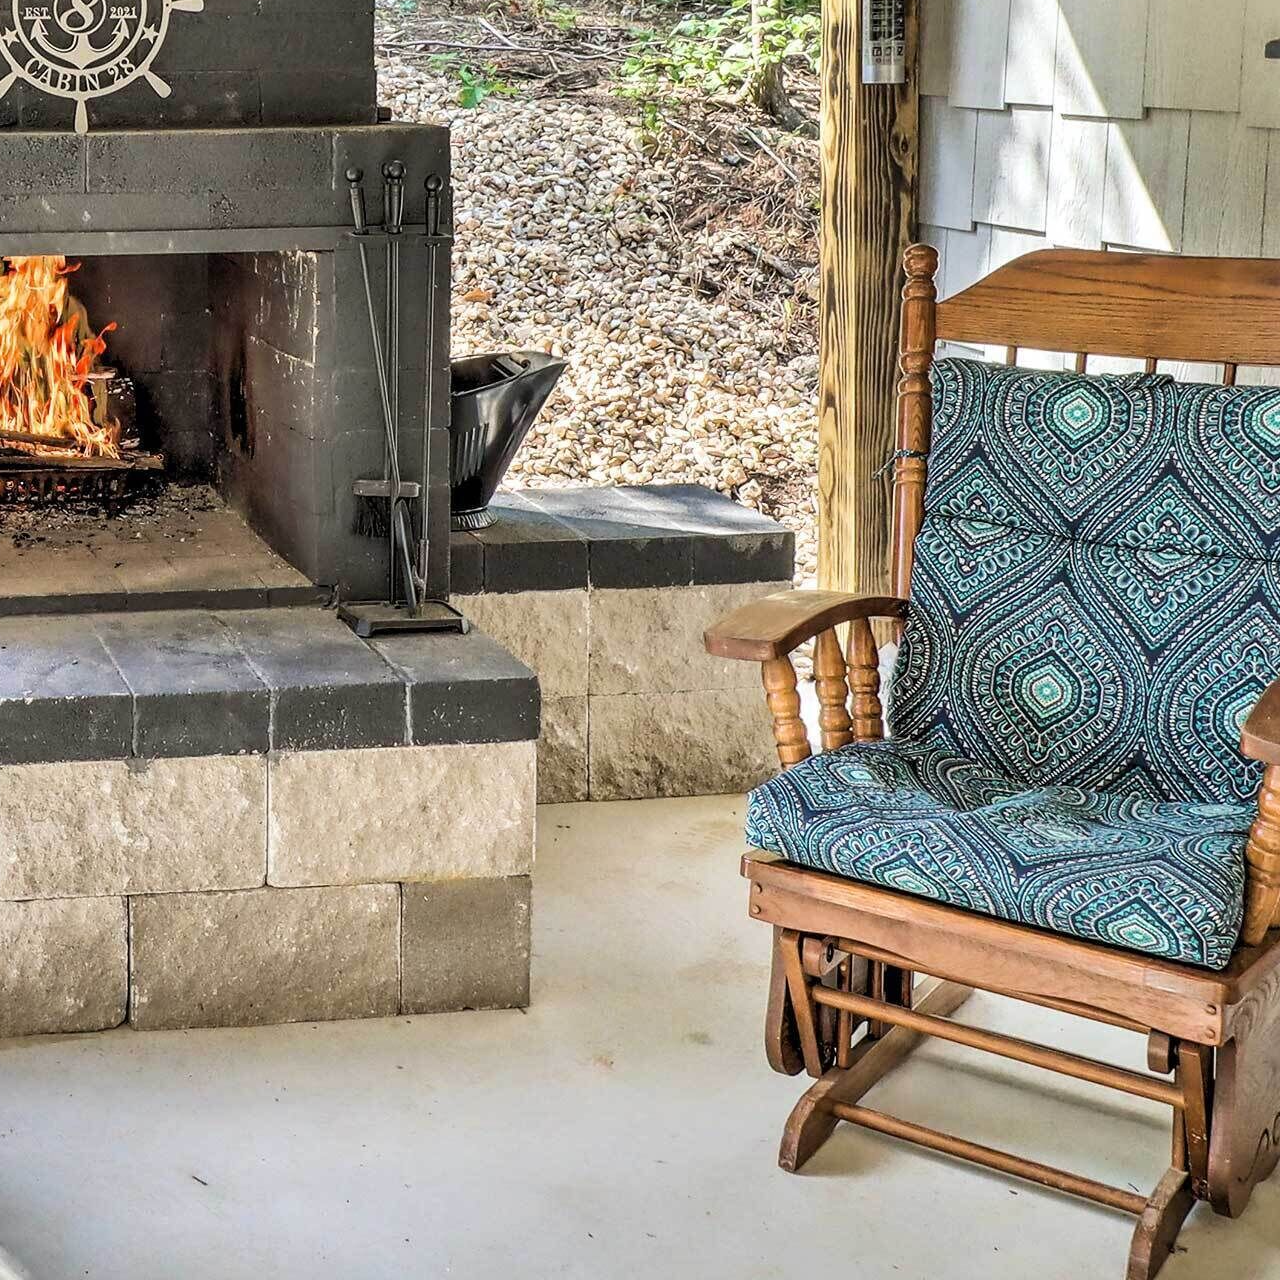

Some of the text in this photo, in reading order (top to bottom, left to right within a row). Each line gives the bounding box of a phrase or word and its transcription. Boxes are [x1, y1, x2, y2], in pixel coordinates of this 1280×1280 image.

[24, 7, 51, 19] EST.
[110, 6, 137, 19] 2021
[23, 56, 136, 92] CABIN 28
